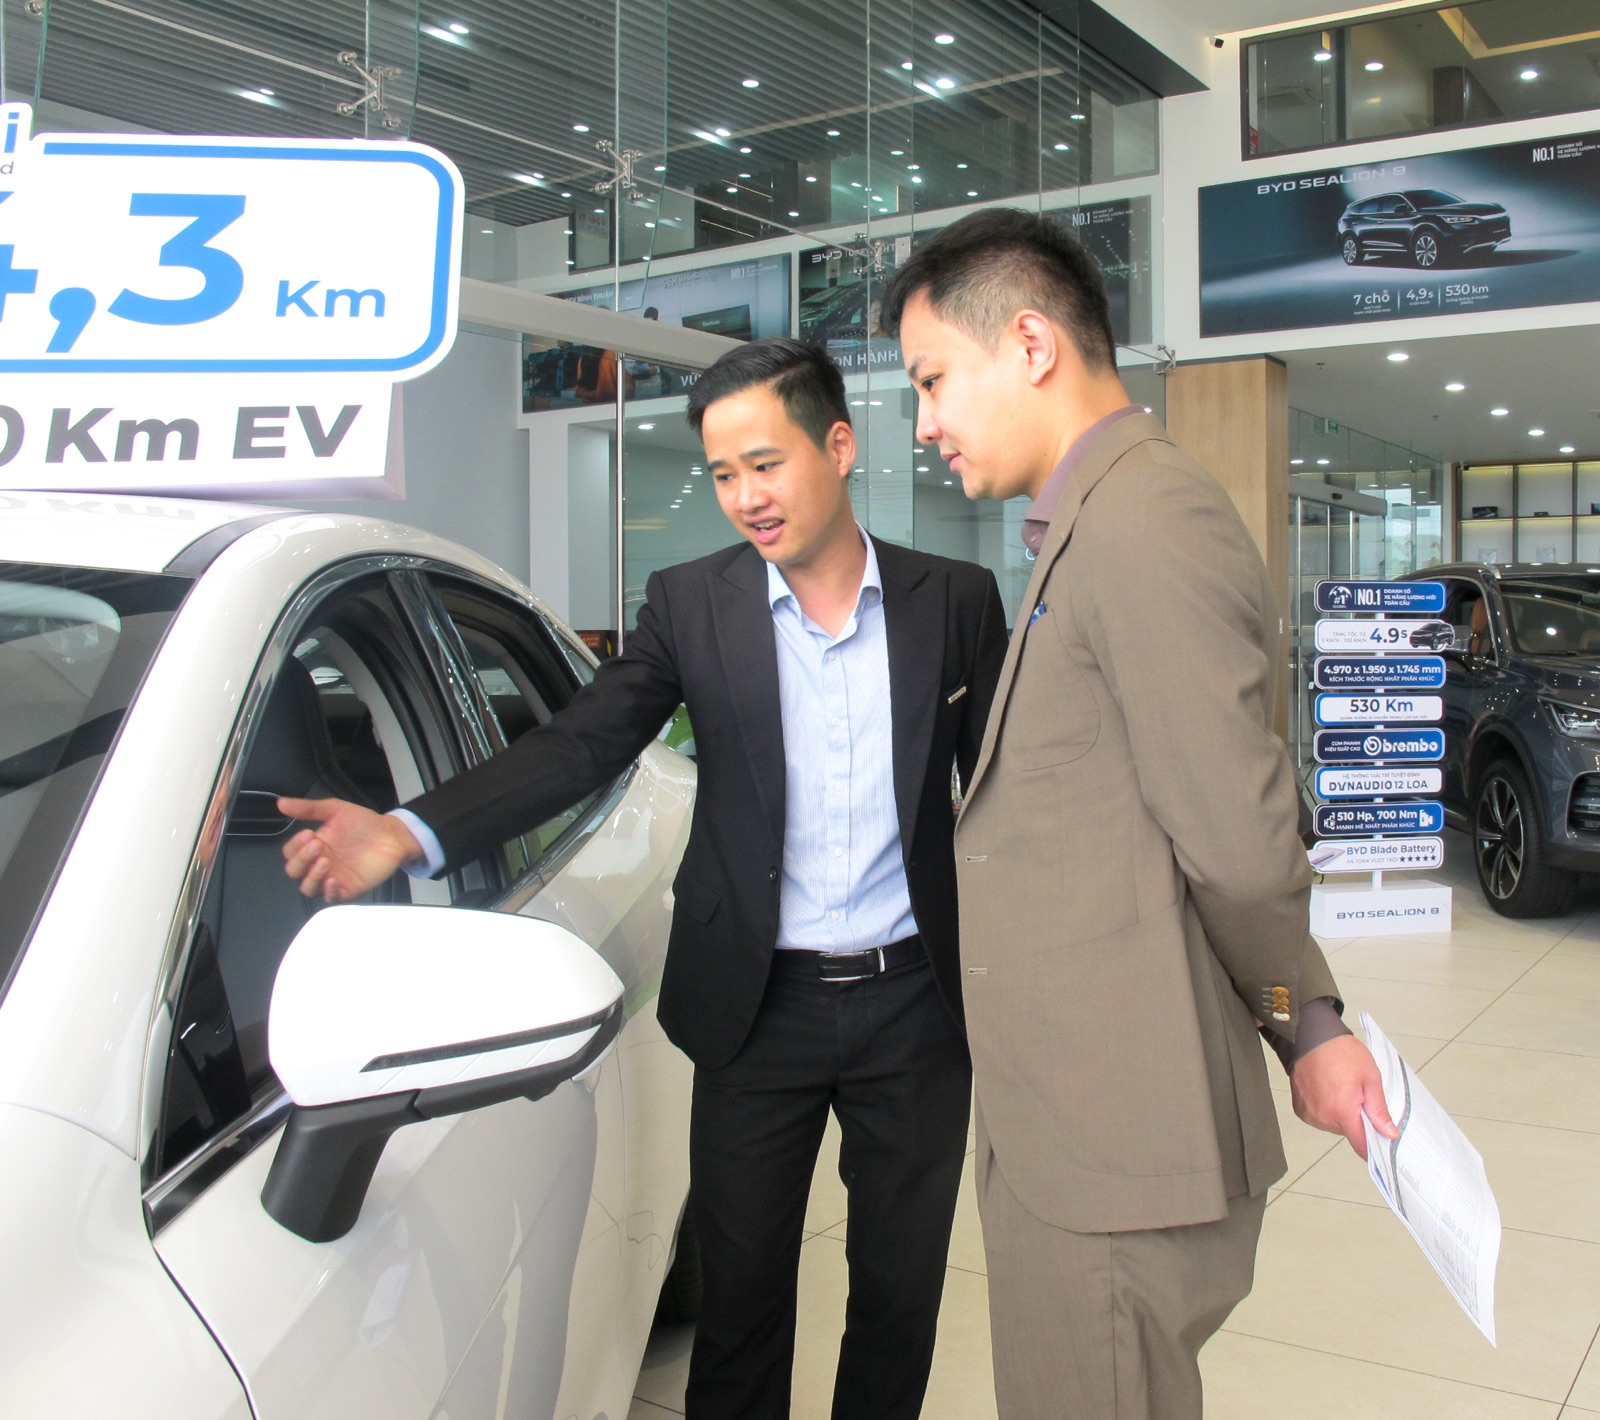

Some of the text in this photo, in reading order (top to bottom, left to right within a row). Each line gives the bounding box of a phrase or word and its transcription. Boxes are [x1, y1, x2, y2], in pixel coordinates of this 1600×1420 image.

[1533, 147, 1554, 162] NO.1
[1257, 165, 1406, 195] BYD SEALION 8
[1072, 212, 1091, 227] NO.1
[1445, 284, 1489, 297] 530 km
[275, 280, 386, 318] Km
[1353, 294, 1362, 305] 7
[681, 371, 702, 387] VỮ
[45, 407, 200, 463] Km
[232, 404, 363, 459] EV
[1357, 589, 1380, 605] NO.1
[1324, 665, 1351, 675] 4.970
[1363, 665, 1386, 674] 1.950
[1396, 664, 1419, 673] 1.745
[1421, 665, 1441, 673] mm
[1350, 698, 1413, 712] 530 Km
[1383, 738, 1438, 753] brembo
[1394, 780, 1404, 790] 12
[1407, 780, 1428, 789] LOA
[1337, 810, 1417, 823] 510 Hp, 700 Nm
[1346, 844, 1436, 855] BYD Blade Battery
[1336, 911, 1365, 919] BYD
[1367, 908, 1425, 918] SEALION
